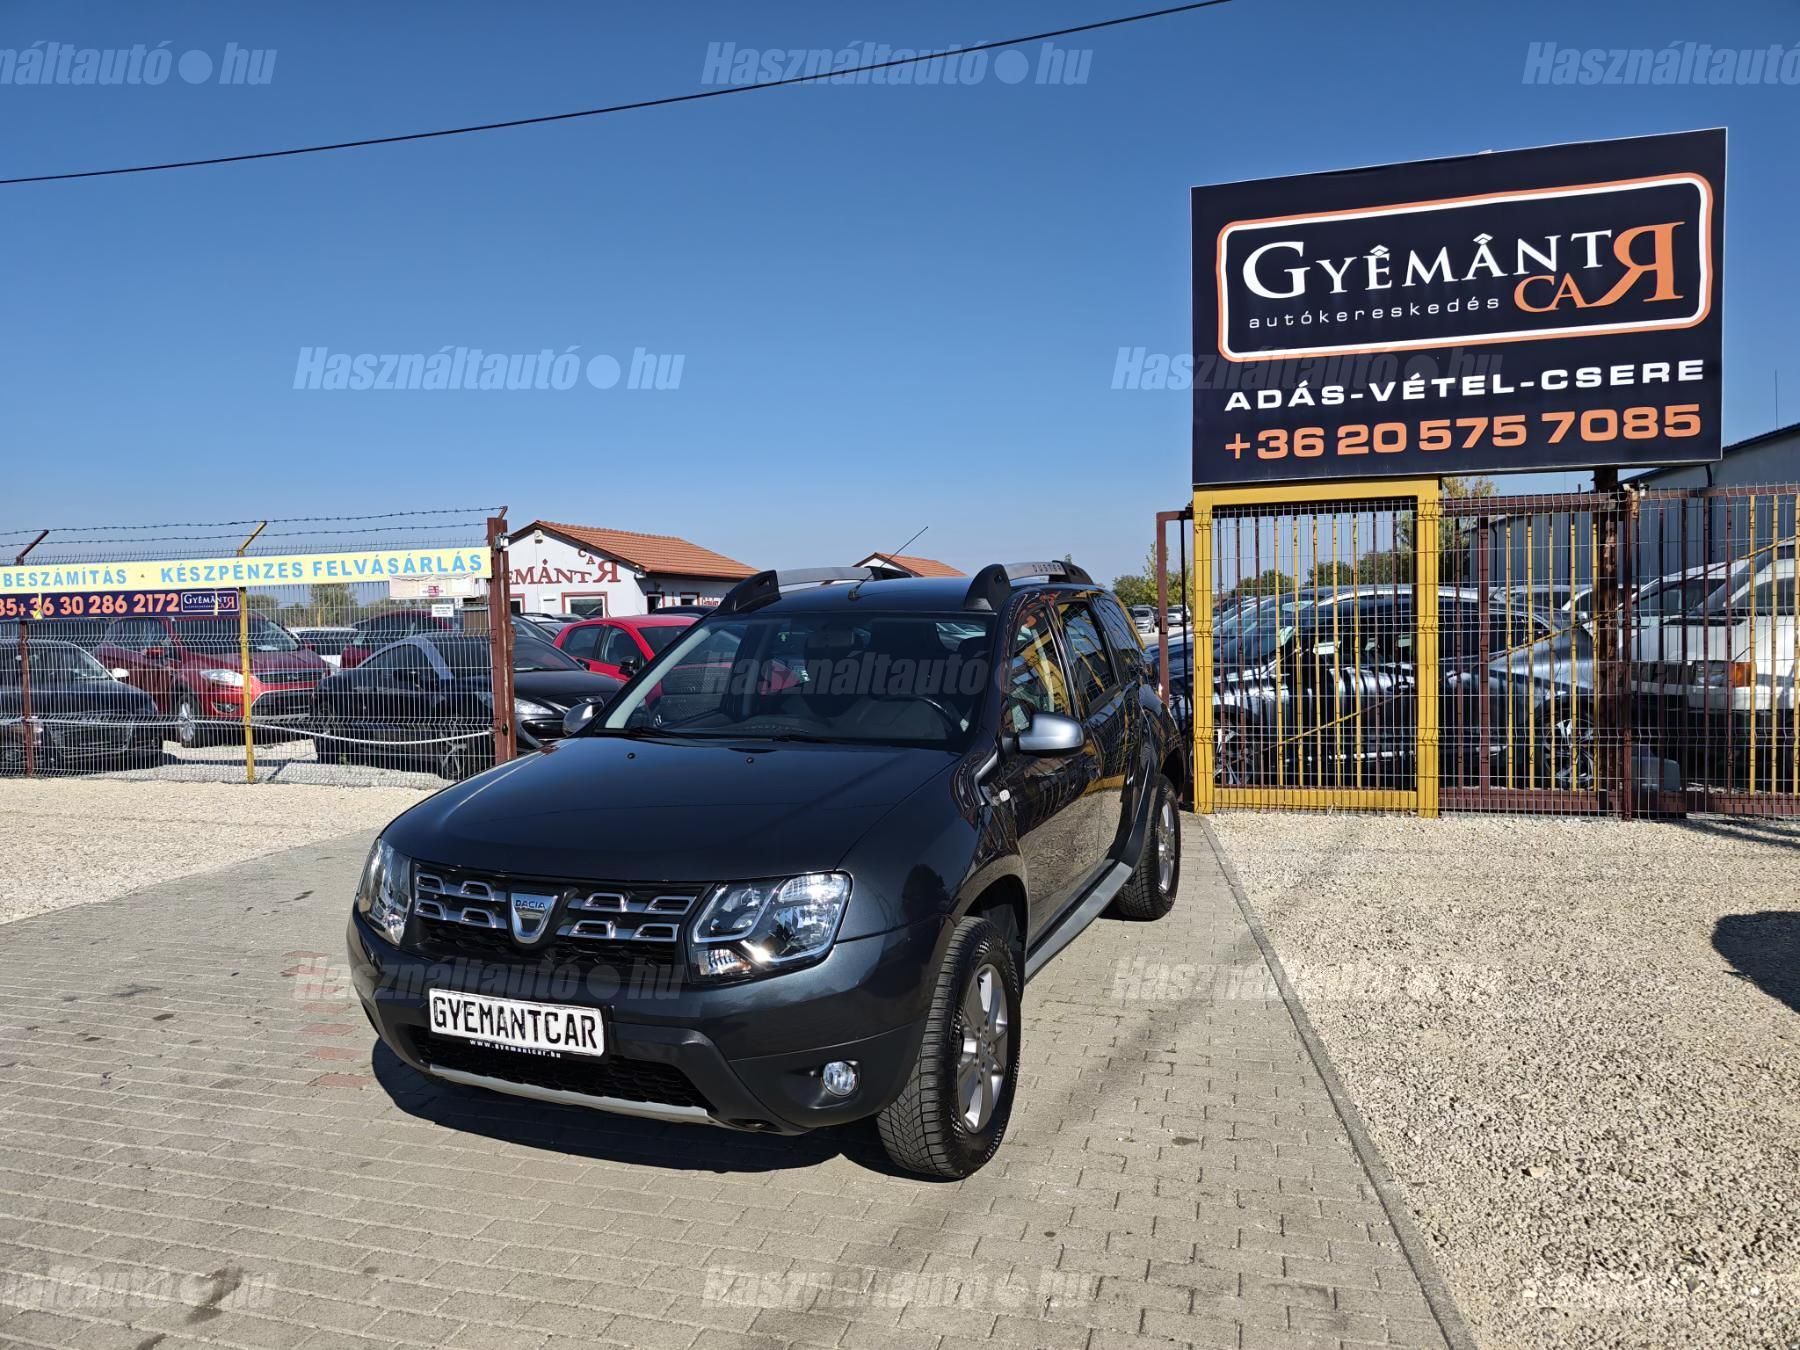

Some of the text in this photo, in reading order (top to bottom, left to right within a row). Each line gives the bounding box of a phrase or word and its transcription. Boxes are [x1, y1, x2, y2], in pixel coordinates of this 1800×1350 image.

[1249, 296, 1499, 329] autókereskedés
[1224, 360, 1704, 411] ADÁS-VÉTEL-CSERE
[1225, 404, 1701, 460] +36 20 575 7085
[3, 552, 482, 588] BESZÁMÍTÁS KÉSZPÉNZES FELVÁSÁRLÁS
[60, 596, 84, 615] 30
[89, 595, 128, 614] 286
[133, 593, 179, 613] 2172
[515, 899, 546, 909] DACIA
[433, 996, 598, 1049] GYEMANTCAR
[469, 1040, 561, 1058] www.gyemantcar.hu
